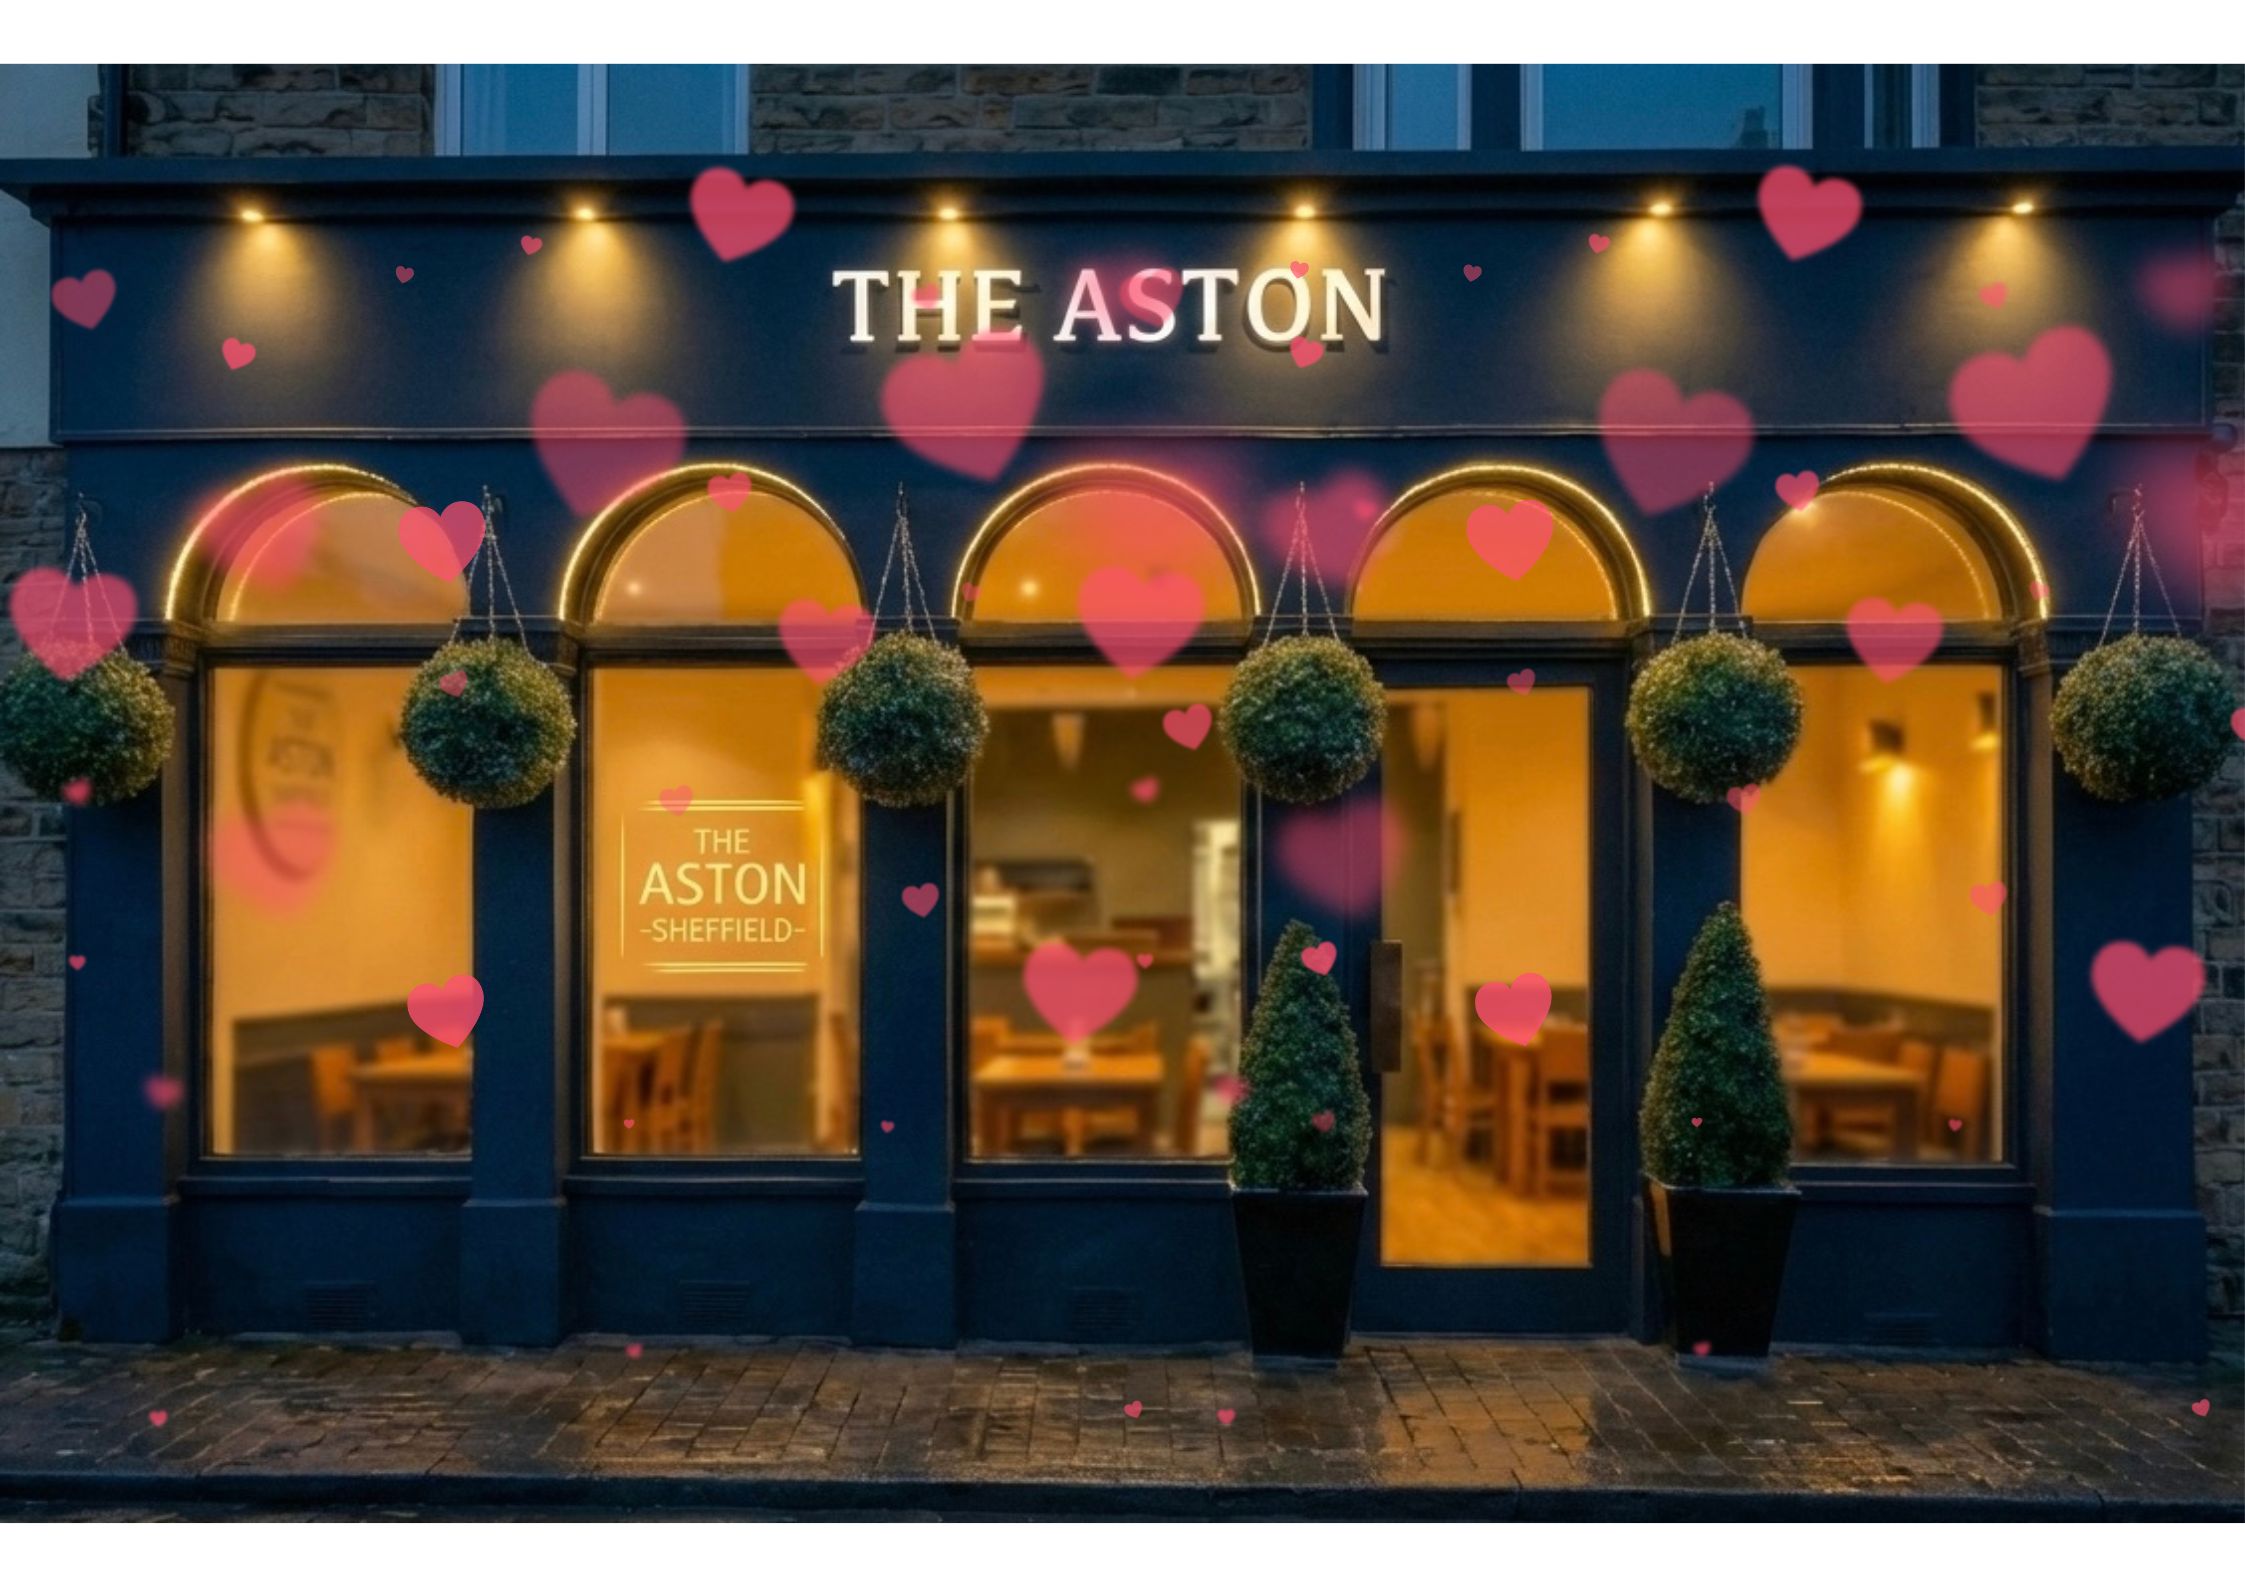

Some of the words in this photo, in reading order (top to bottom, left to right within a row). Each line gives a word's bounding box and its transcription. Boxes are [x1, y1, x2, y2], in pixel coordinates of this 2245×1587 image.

[832, 270, 1024, 343] THE
[1053, 267, 1386, 345] ASTON
[694, 828, 750, 854] THE
[639, 862, 806, 906] ASTON
